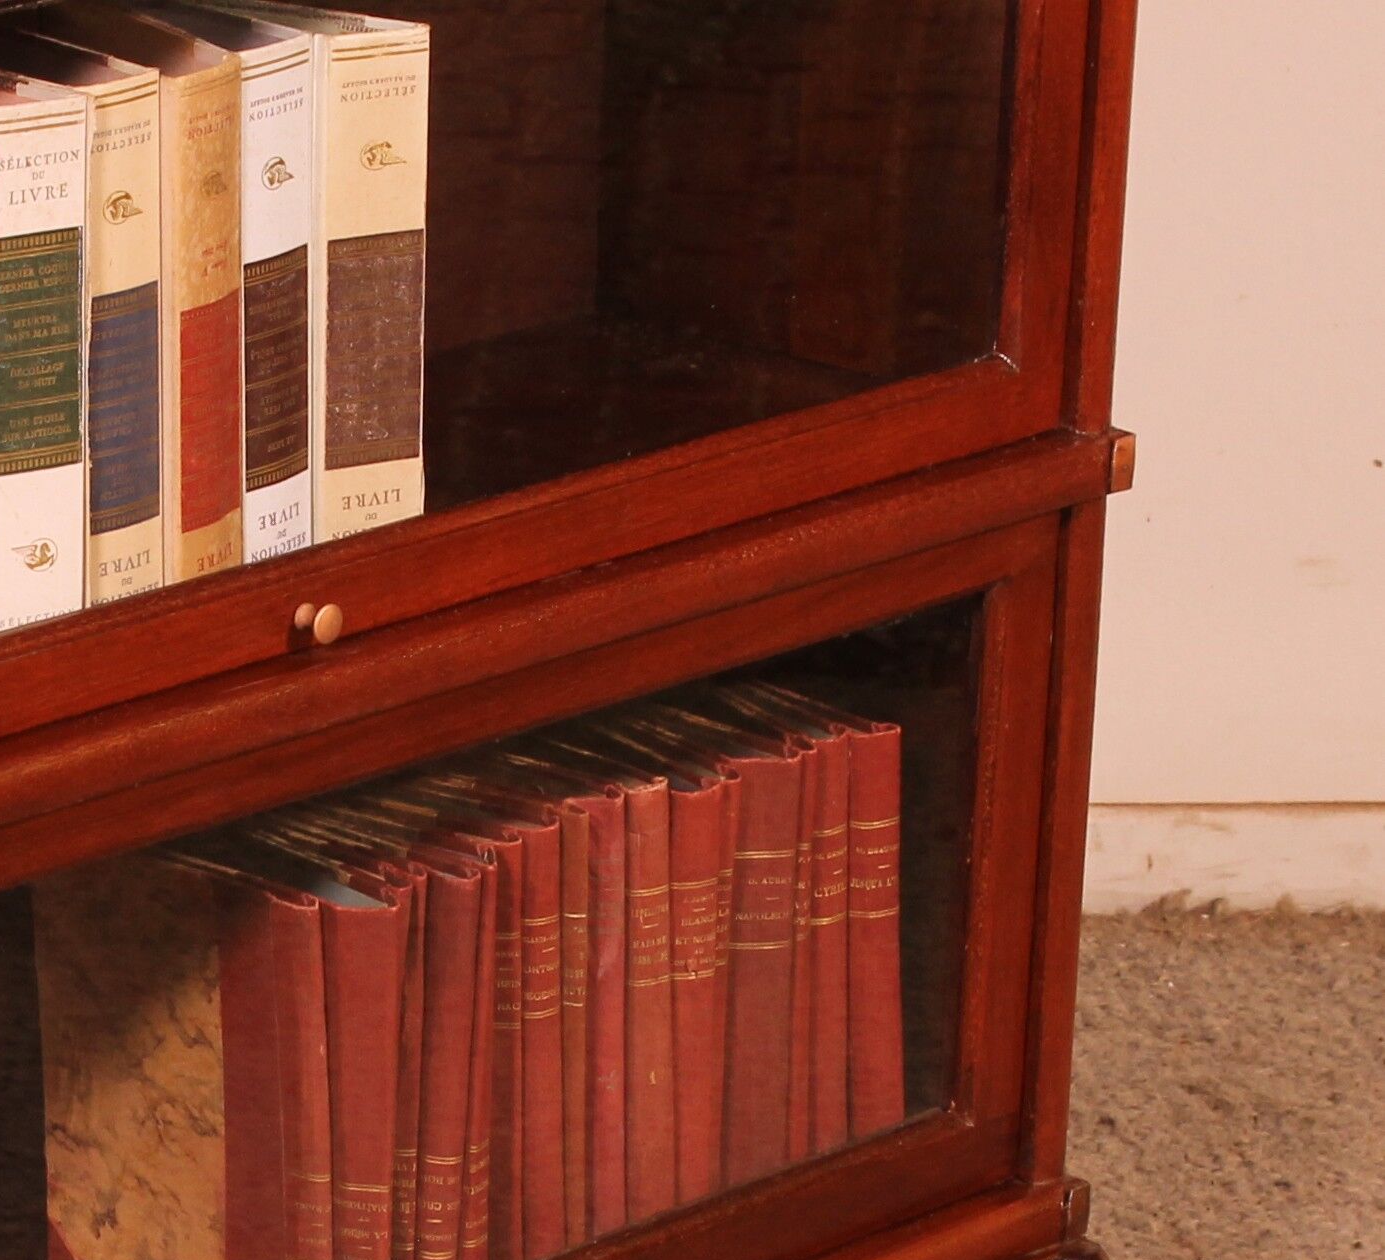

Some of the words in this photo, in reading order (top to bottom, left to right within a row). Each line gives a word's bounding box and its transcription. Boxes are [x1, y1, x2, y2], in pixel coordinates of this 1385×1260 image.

[340, 85, 416, 103] SÉLECTION
[32, 170, 45, 181] DU
[9, 183, 69, 206] LIVRE
[342, 488, 401, 511] LIVRE
[258, 502, 300, 531] LIVRE
[99, 549, 150, 577] LIVRE
